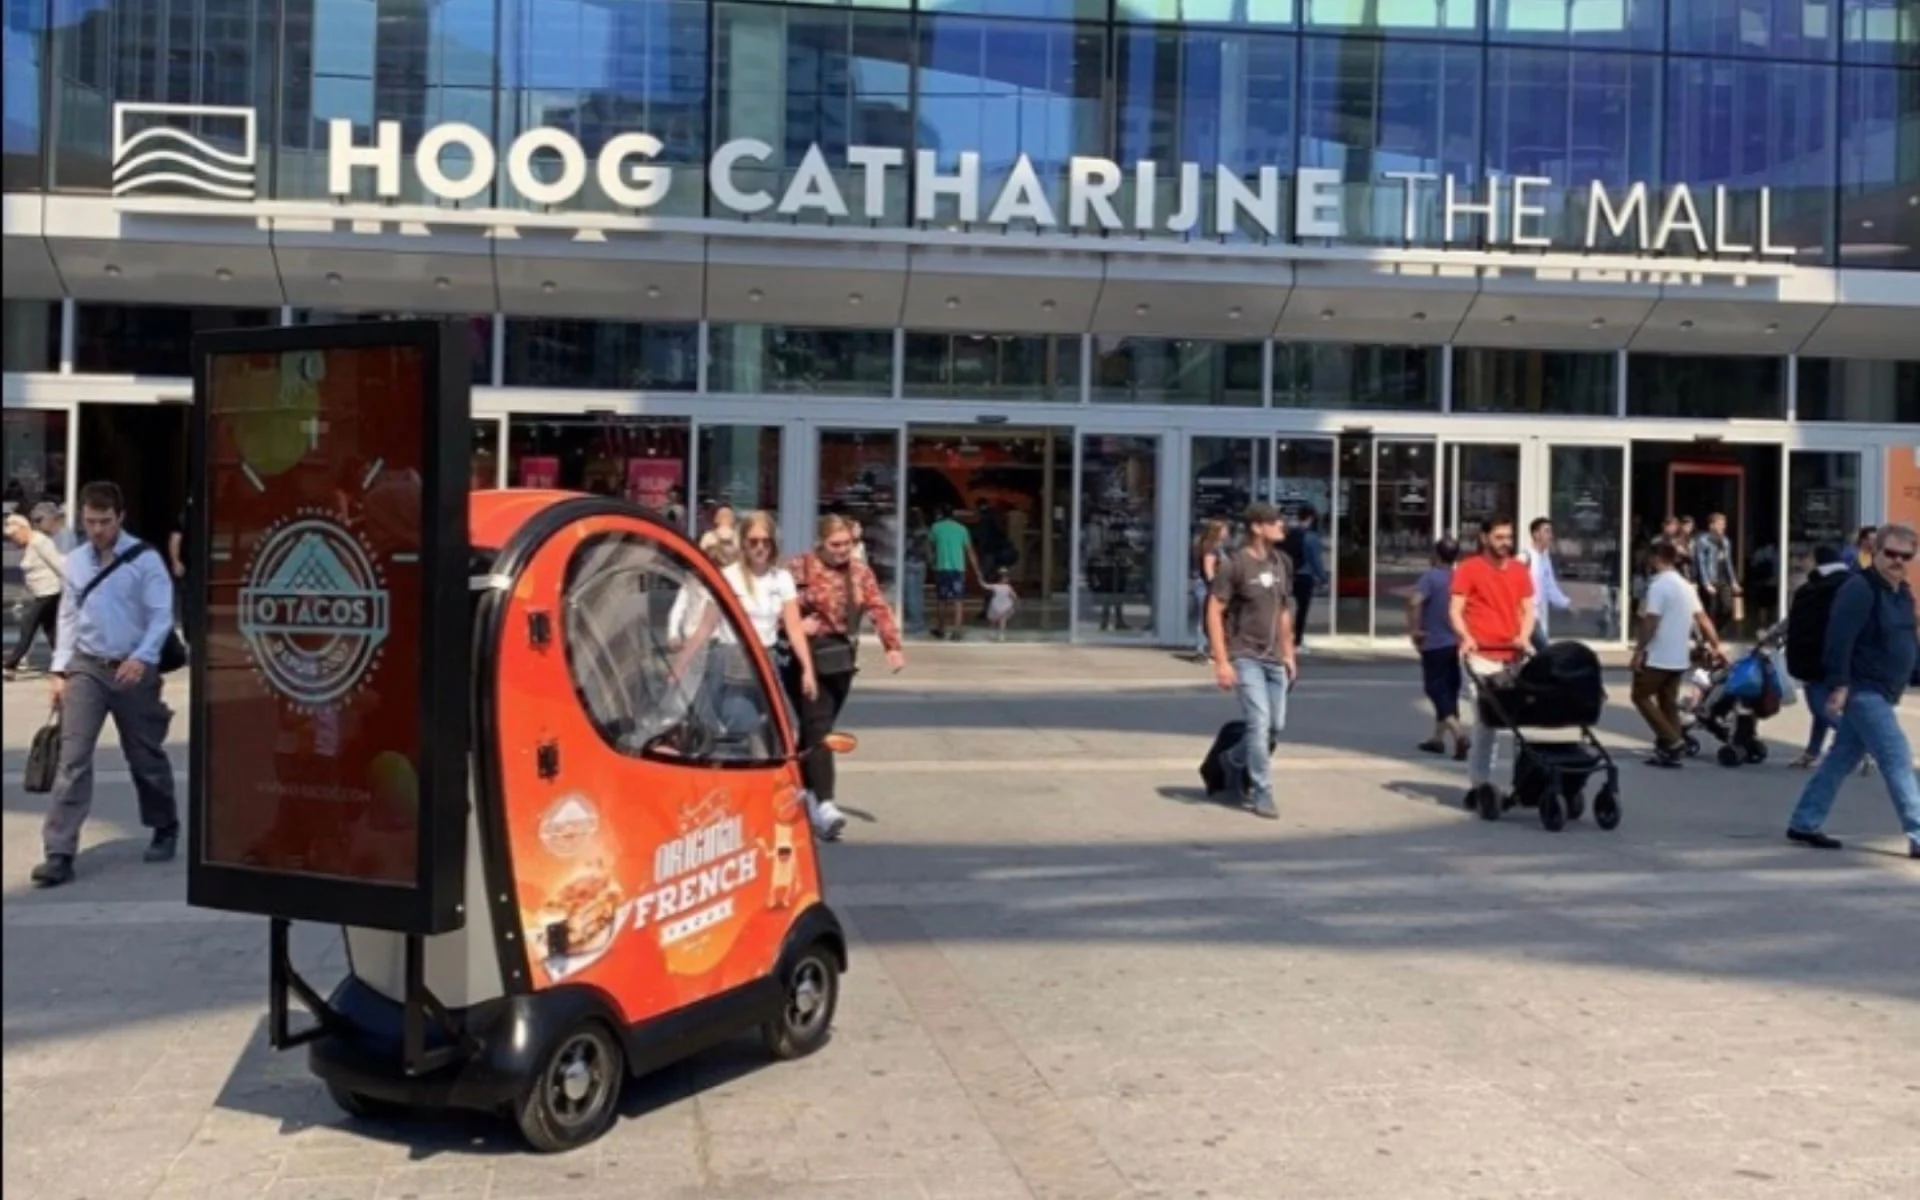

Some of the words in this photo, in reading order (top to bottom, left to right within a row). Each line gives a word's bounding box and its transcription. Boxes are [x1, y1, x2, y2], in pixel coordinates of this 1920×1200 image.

[329, 118, 672, 208] HOOG
[709, 138, 1342, 237] CATHARIJNE
[1382, 171, 1552, 246] THE
[1585, 179, 1797, 255] MALL
[633, 847, 758, 930] FRENCH
